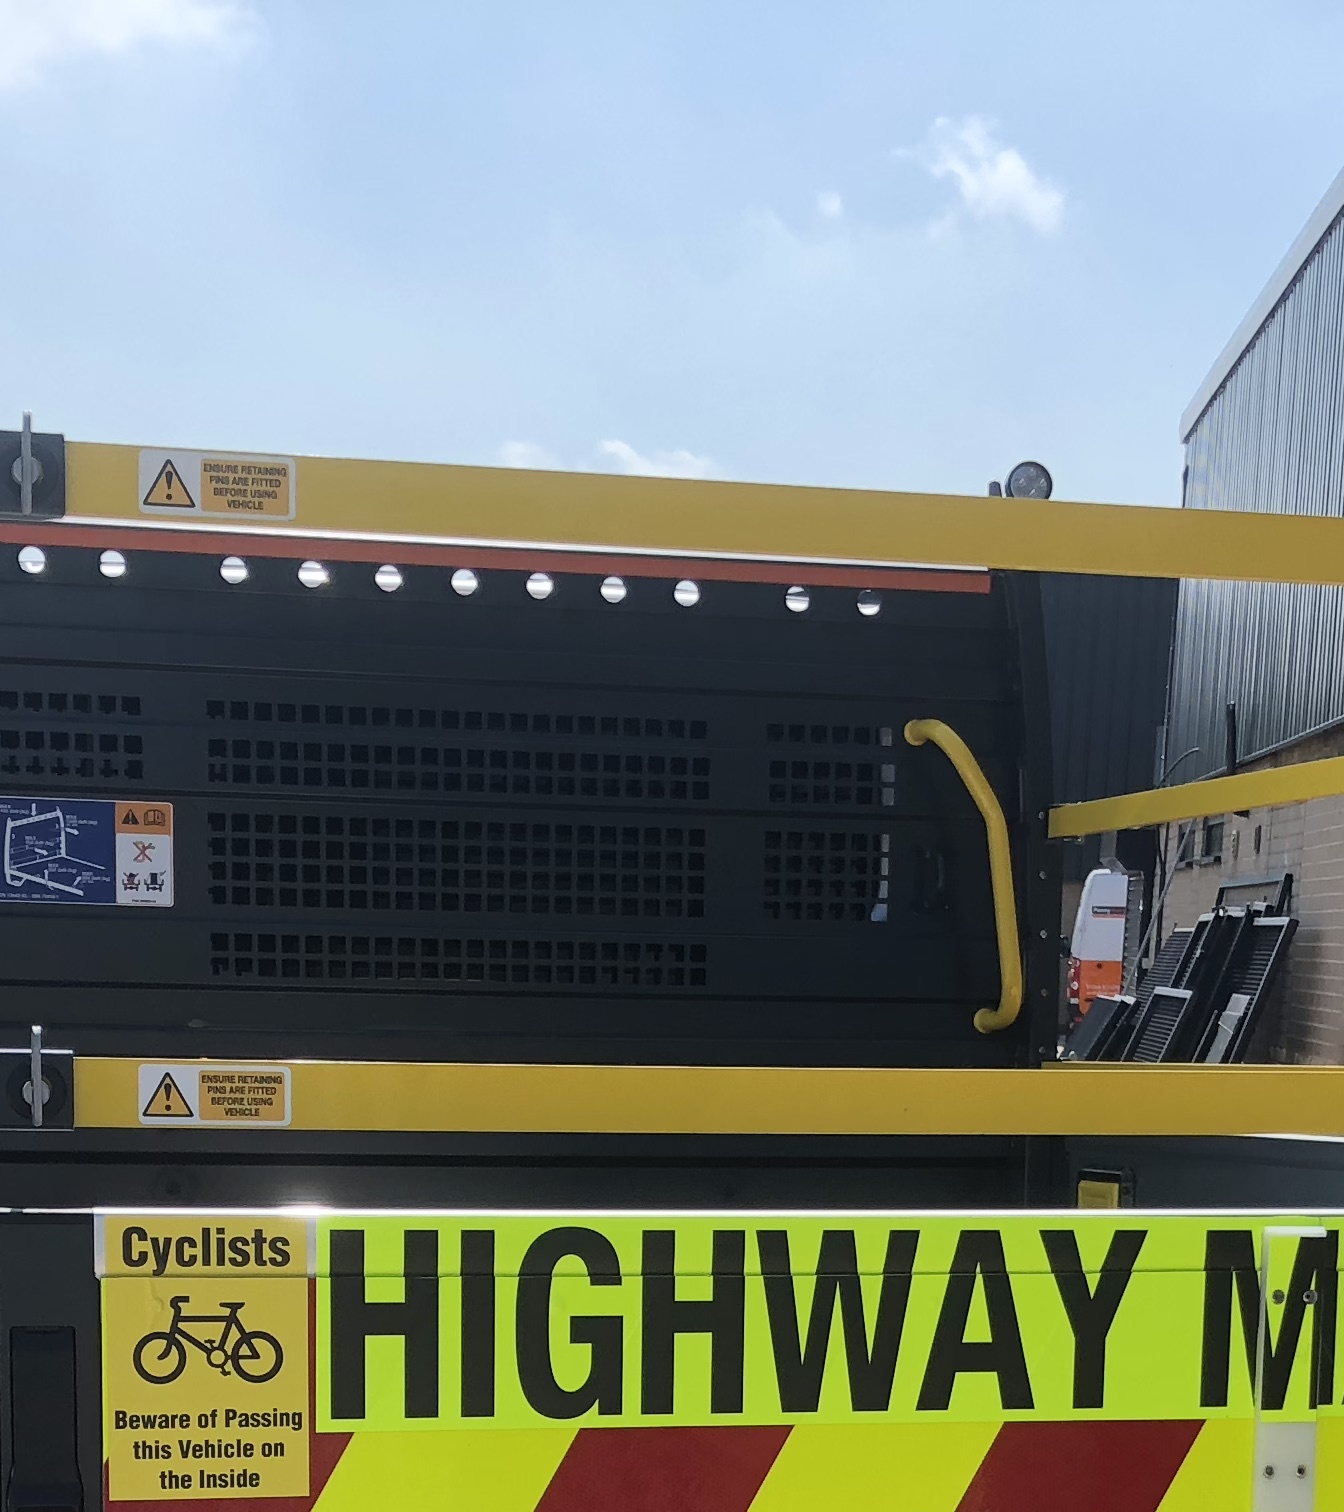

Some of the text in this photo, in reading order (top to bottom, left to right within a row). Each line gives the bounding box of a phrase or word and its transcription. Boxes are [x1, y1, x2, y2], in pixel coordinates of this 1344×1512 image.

[203, 463, 287, 477] ENSURE RETAINING
[209, 476, 282, 488] PINS ARE FITTED
[213, 488, 278, 499] BEFORE USING
[227, 500, 264, 510] VEHICLE
[201, 1074, 283, 1085] ENSURE RETAINING
[207, 1086, 277, 1096] PINS ARE FITTED
[211, 1097, 274, 1106] BEFORE USING
[224, 1108, 260, 1117] VEHICLE
[121, 1226, 291, 1276] Cyclists
[328, 1226, 1149, 1420] HIGHWAY
[114, 1408, 303, 1431] Beware of Passing
[133, 1439, 285, 1460] this Vehicle on
[159, 1469, 261, 1490] the Inside
